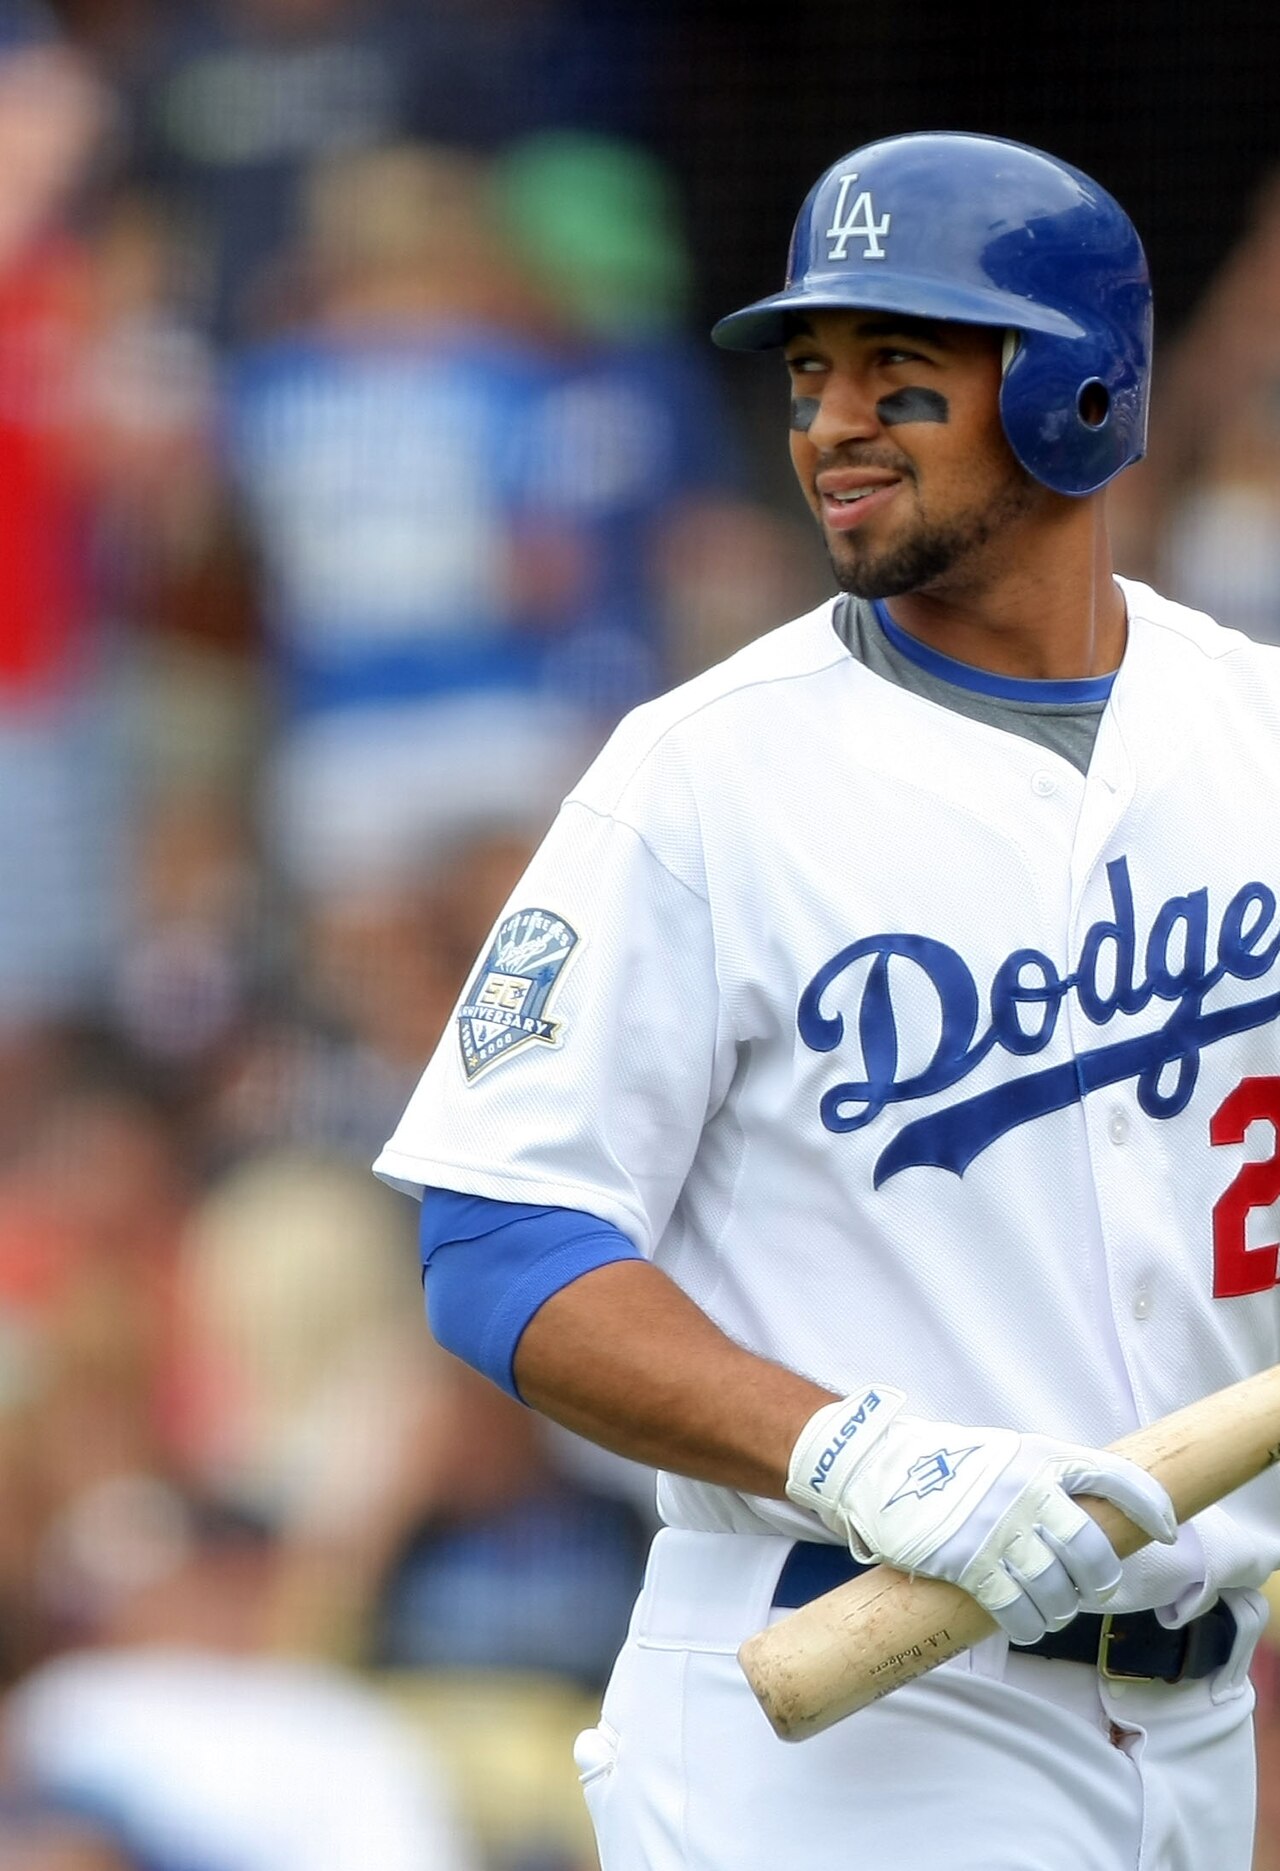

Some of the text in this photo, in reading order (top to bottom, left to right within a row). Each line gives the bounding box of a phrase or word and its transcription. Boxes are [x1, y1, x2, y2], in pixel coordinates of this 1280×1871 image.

[826, 172, 891, 261] LA
[809, 1390, 882, 1494] EASTON
[868, 1644, 923, 1677] Dodgers
